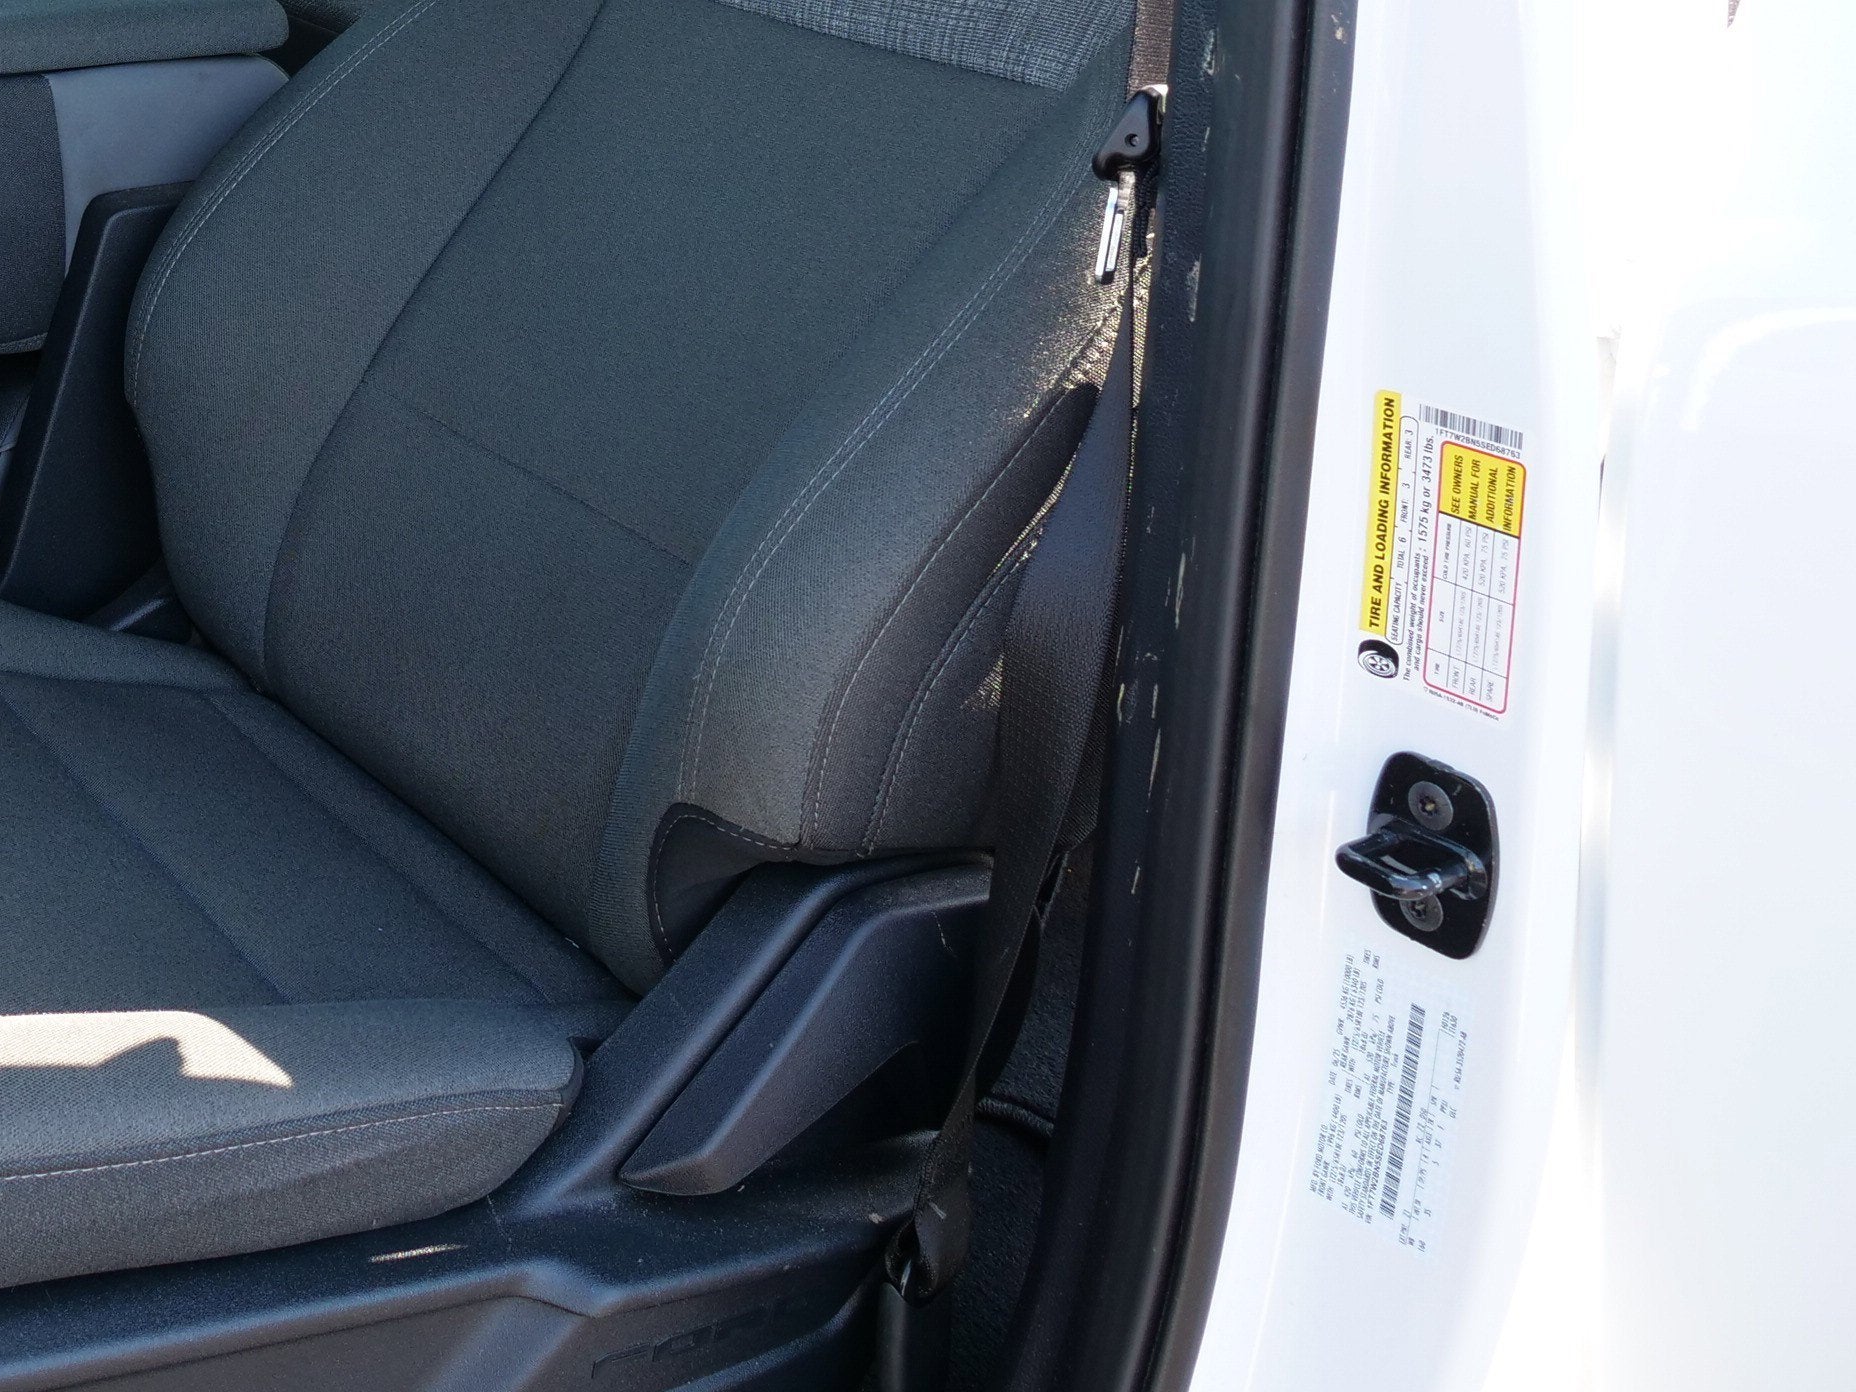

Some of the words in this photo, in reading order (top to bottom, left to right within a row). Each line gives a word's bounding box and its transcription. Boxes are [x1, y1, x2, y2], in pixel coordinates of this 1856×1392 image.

[1379, 397, 1395, 495] INFORMATION
[1423, 435, 1434, 454] lbs.
[1421, 455, 1433, 483] 3473
[1452, 454, 1464, 494] OWNERS
[1470, 459, 1481, 479] FOR
[1422, 486, 1431, 498] or
[1450, 496, 1461, 514] SEE
[1468, 481, 1479, 521] MANUAL
[1485, 467, 1498, 524] ADDITIONAL
[1502, 465, 1516, 532] INFORMATION
[1419, 500, 1432, 514] kg
[1374, 499, 1389, 561] LOADING
[1417, 515, 1429, 542] 1575
[1372, 564, 1384, 594] AND
[1412, 552, 1423, 592] occupants
[1421, 554, 1429, 582] exceed
[1393, 582, 1402, 614] CAPACITY
[1410, 592, 1417, 601] of
[1419, 584, 1427, 605] never
[1369, 596, 1382, 628] TIRE
[1408, 602, 1417, 628] weight
[1416, 606, 1425, 632] should
[1391, 614, 1400, 642] SEATING
[1405, 629, 1415, 666] combined
[1415, 634, 1424, 655] cargo
[1403, 667, 1411, 681] The
[1383, 1034, 1393, 1056] SHOWN
[1377, 1055, 1390, 1097] MANUFACTURE
[1364, 1097, 1375, 1130] APPLICABLE
[1317, 1133, 1327, 1154] MOTOR
[1313, 1153, 1323, 1170] FORD
[1317, 1177, 1327, 1197] FRONT
